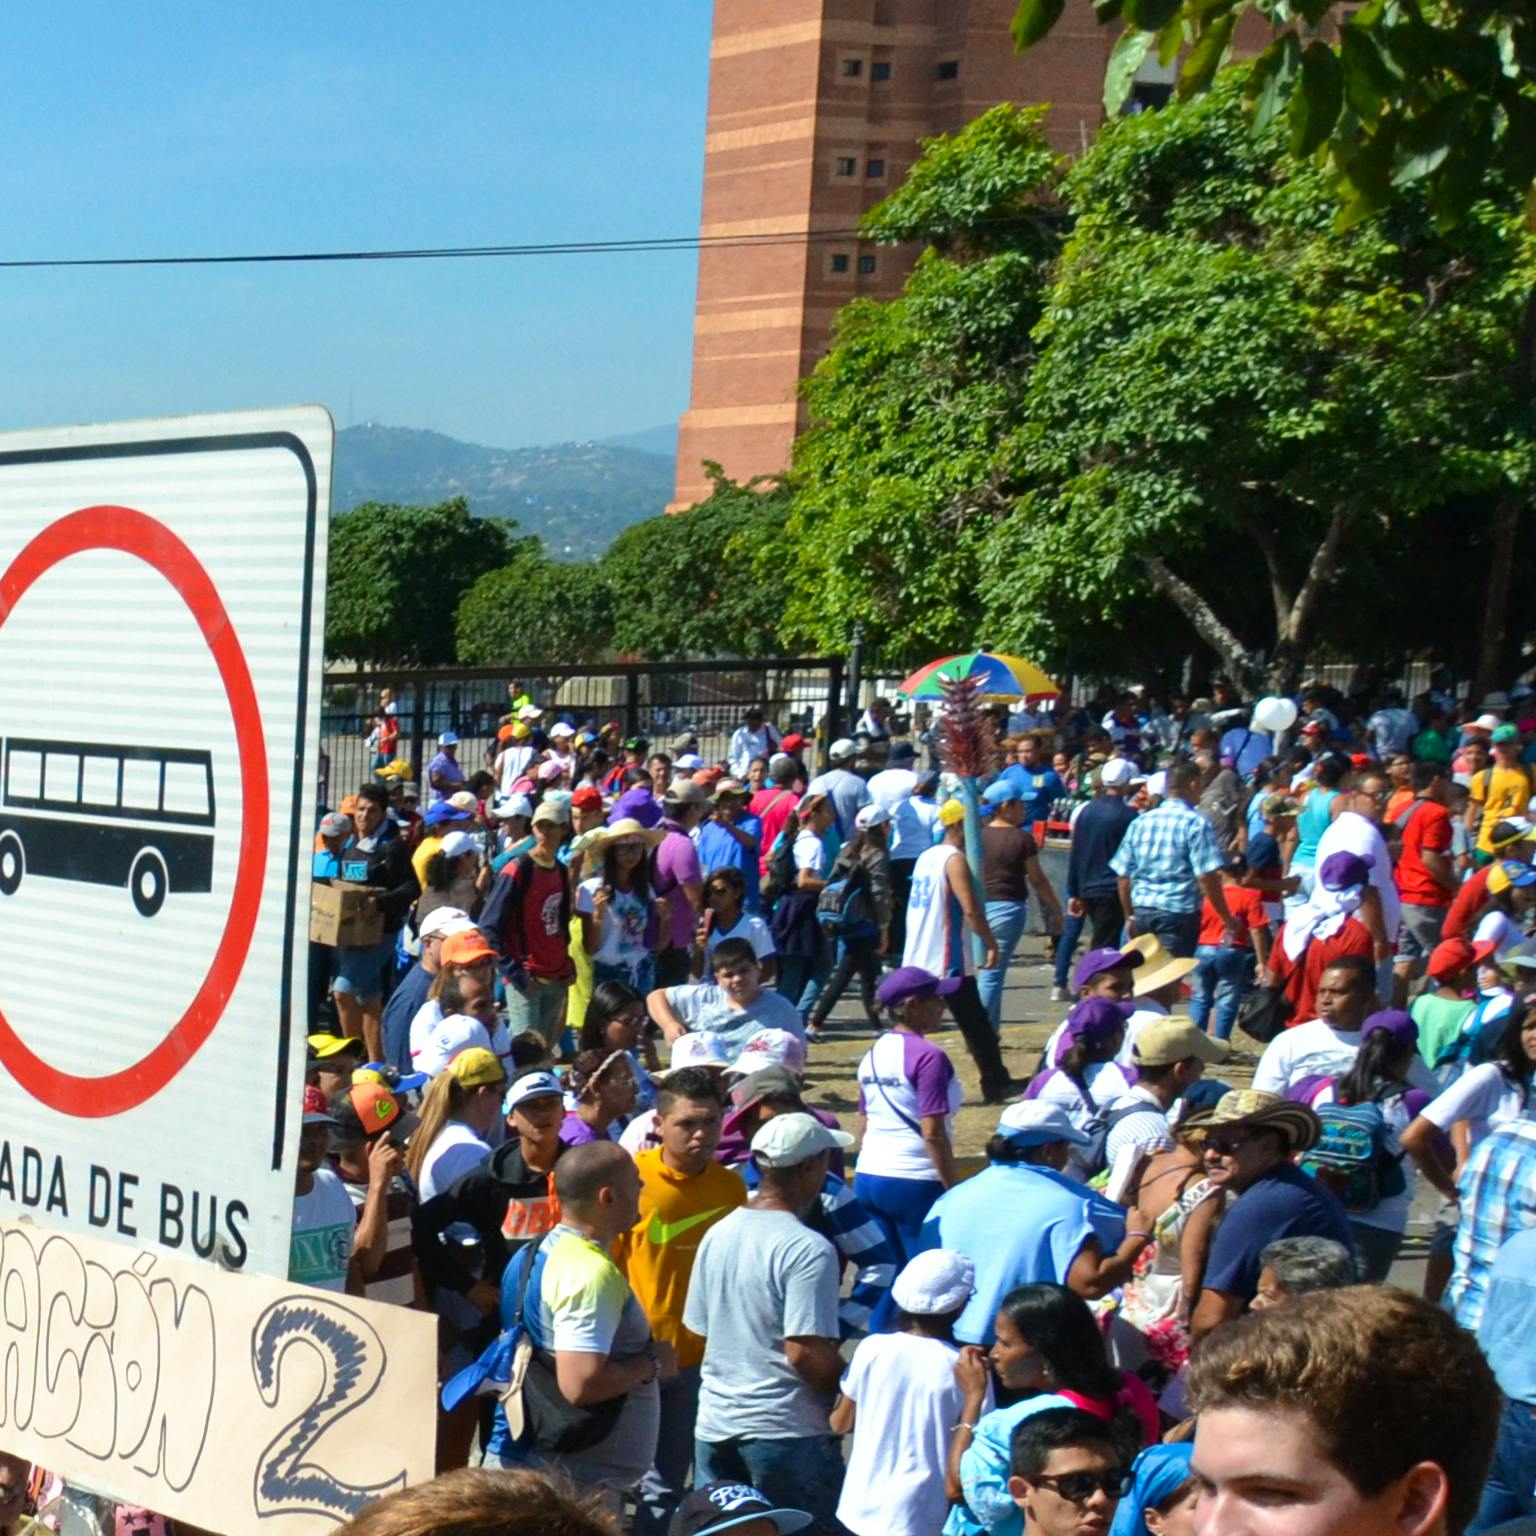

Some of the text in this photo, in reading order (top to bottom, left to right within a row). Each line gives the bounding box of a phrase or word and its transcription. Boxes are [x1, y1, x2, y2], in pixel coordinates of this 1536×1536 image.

[88, 1164, 139, 1238] DE
[159, 1182, 249, 1269] BUS
[251, 1294, 407, 1525] 2
